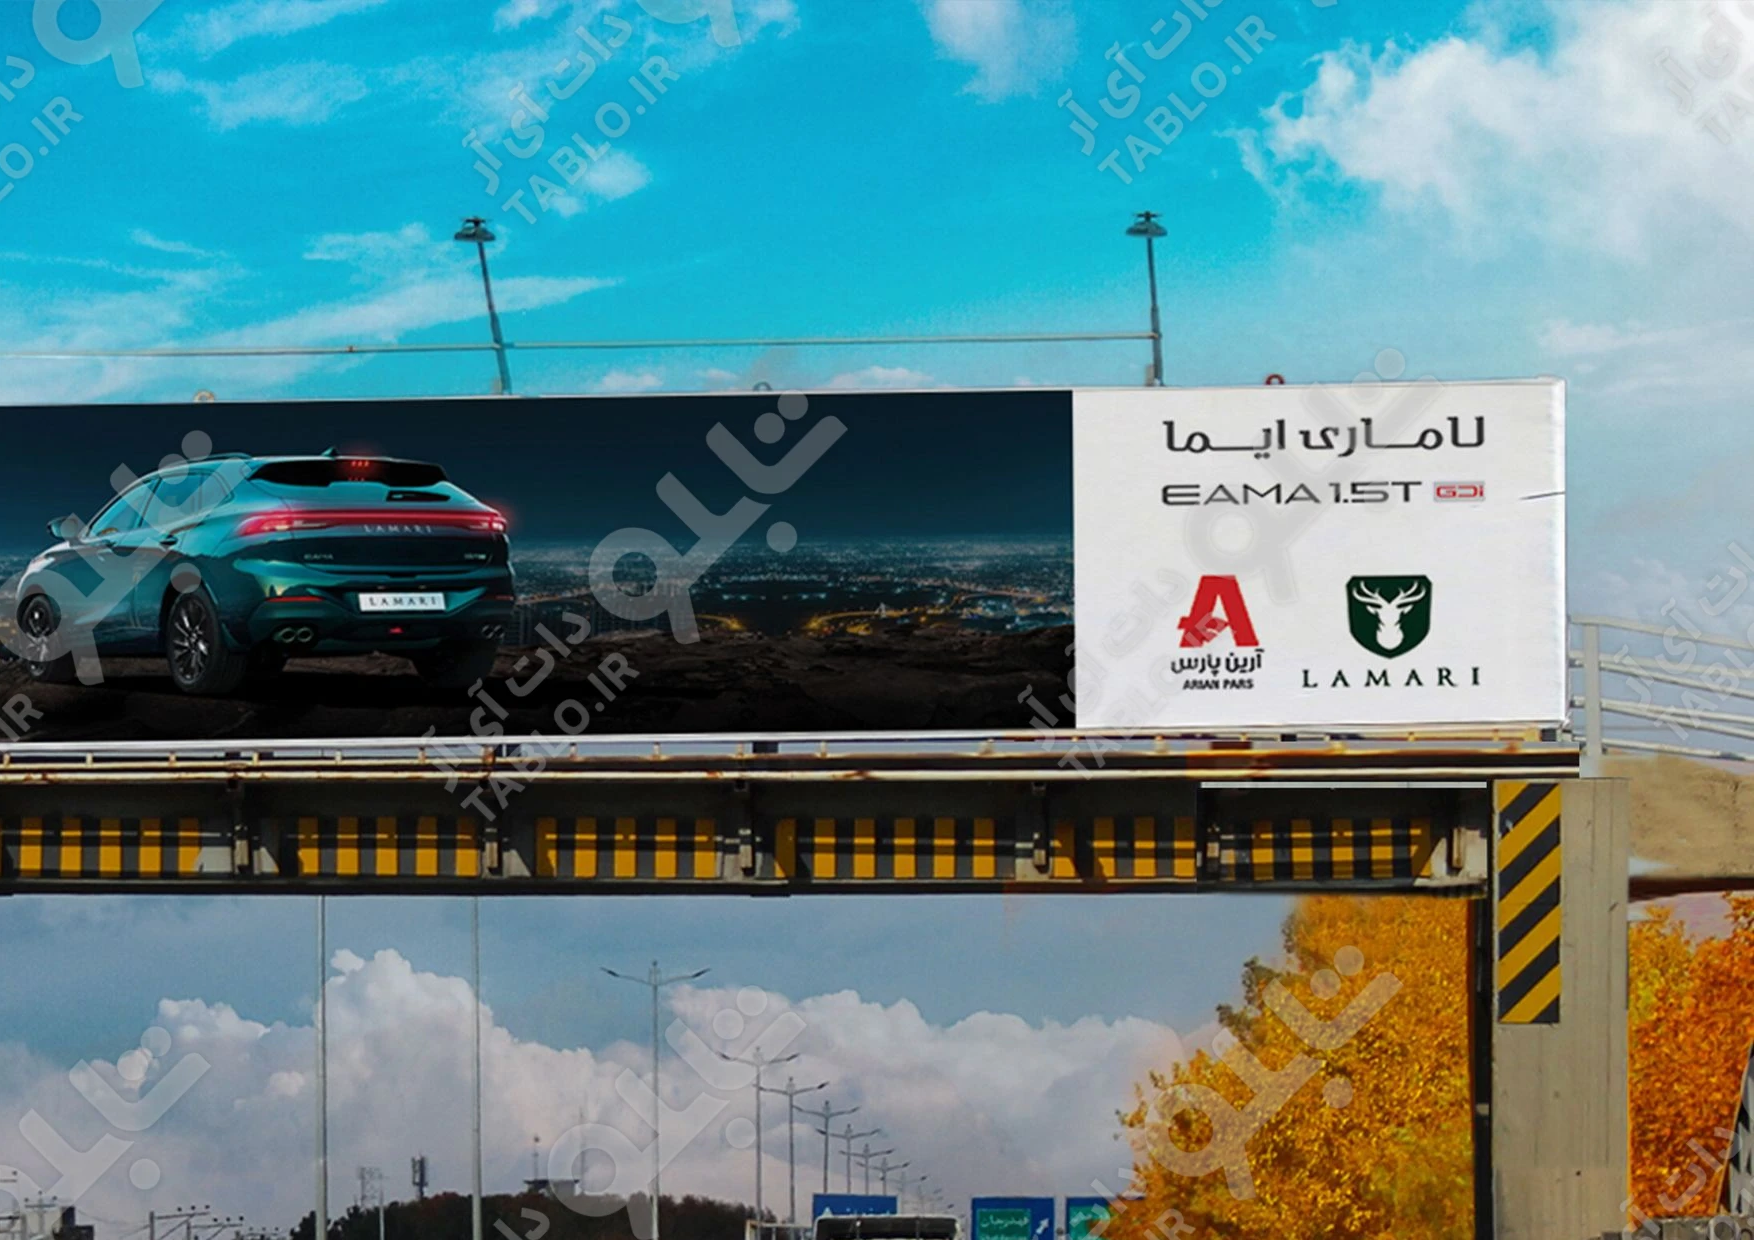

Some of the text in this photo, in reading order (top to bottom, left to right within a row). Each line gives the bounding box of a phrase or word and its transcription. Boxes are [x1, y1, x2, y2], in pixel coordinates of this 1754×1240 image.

[1162, 416, 1485, 459] لاماری ایما
[363, 523, 433, 534] LAMARI
[368, 597, 437, 607] LAMARI
[1170, 649, 1265, 677] آرین پارس
[1182, 678, 1255, 690] ARIAN PARS
[1302, 666, 1481, 689] LAMARI
